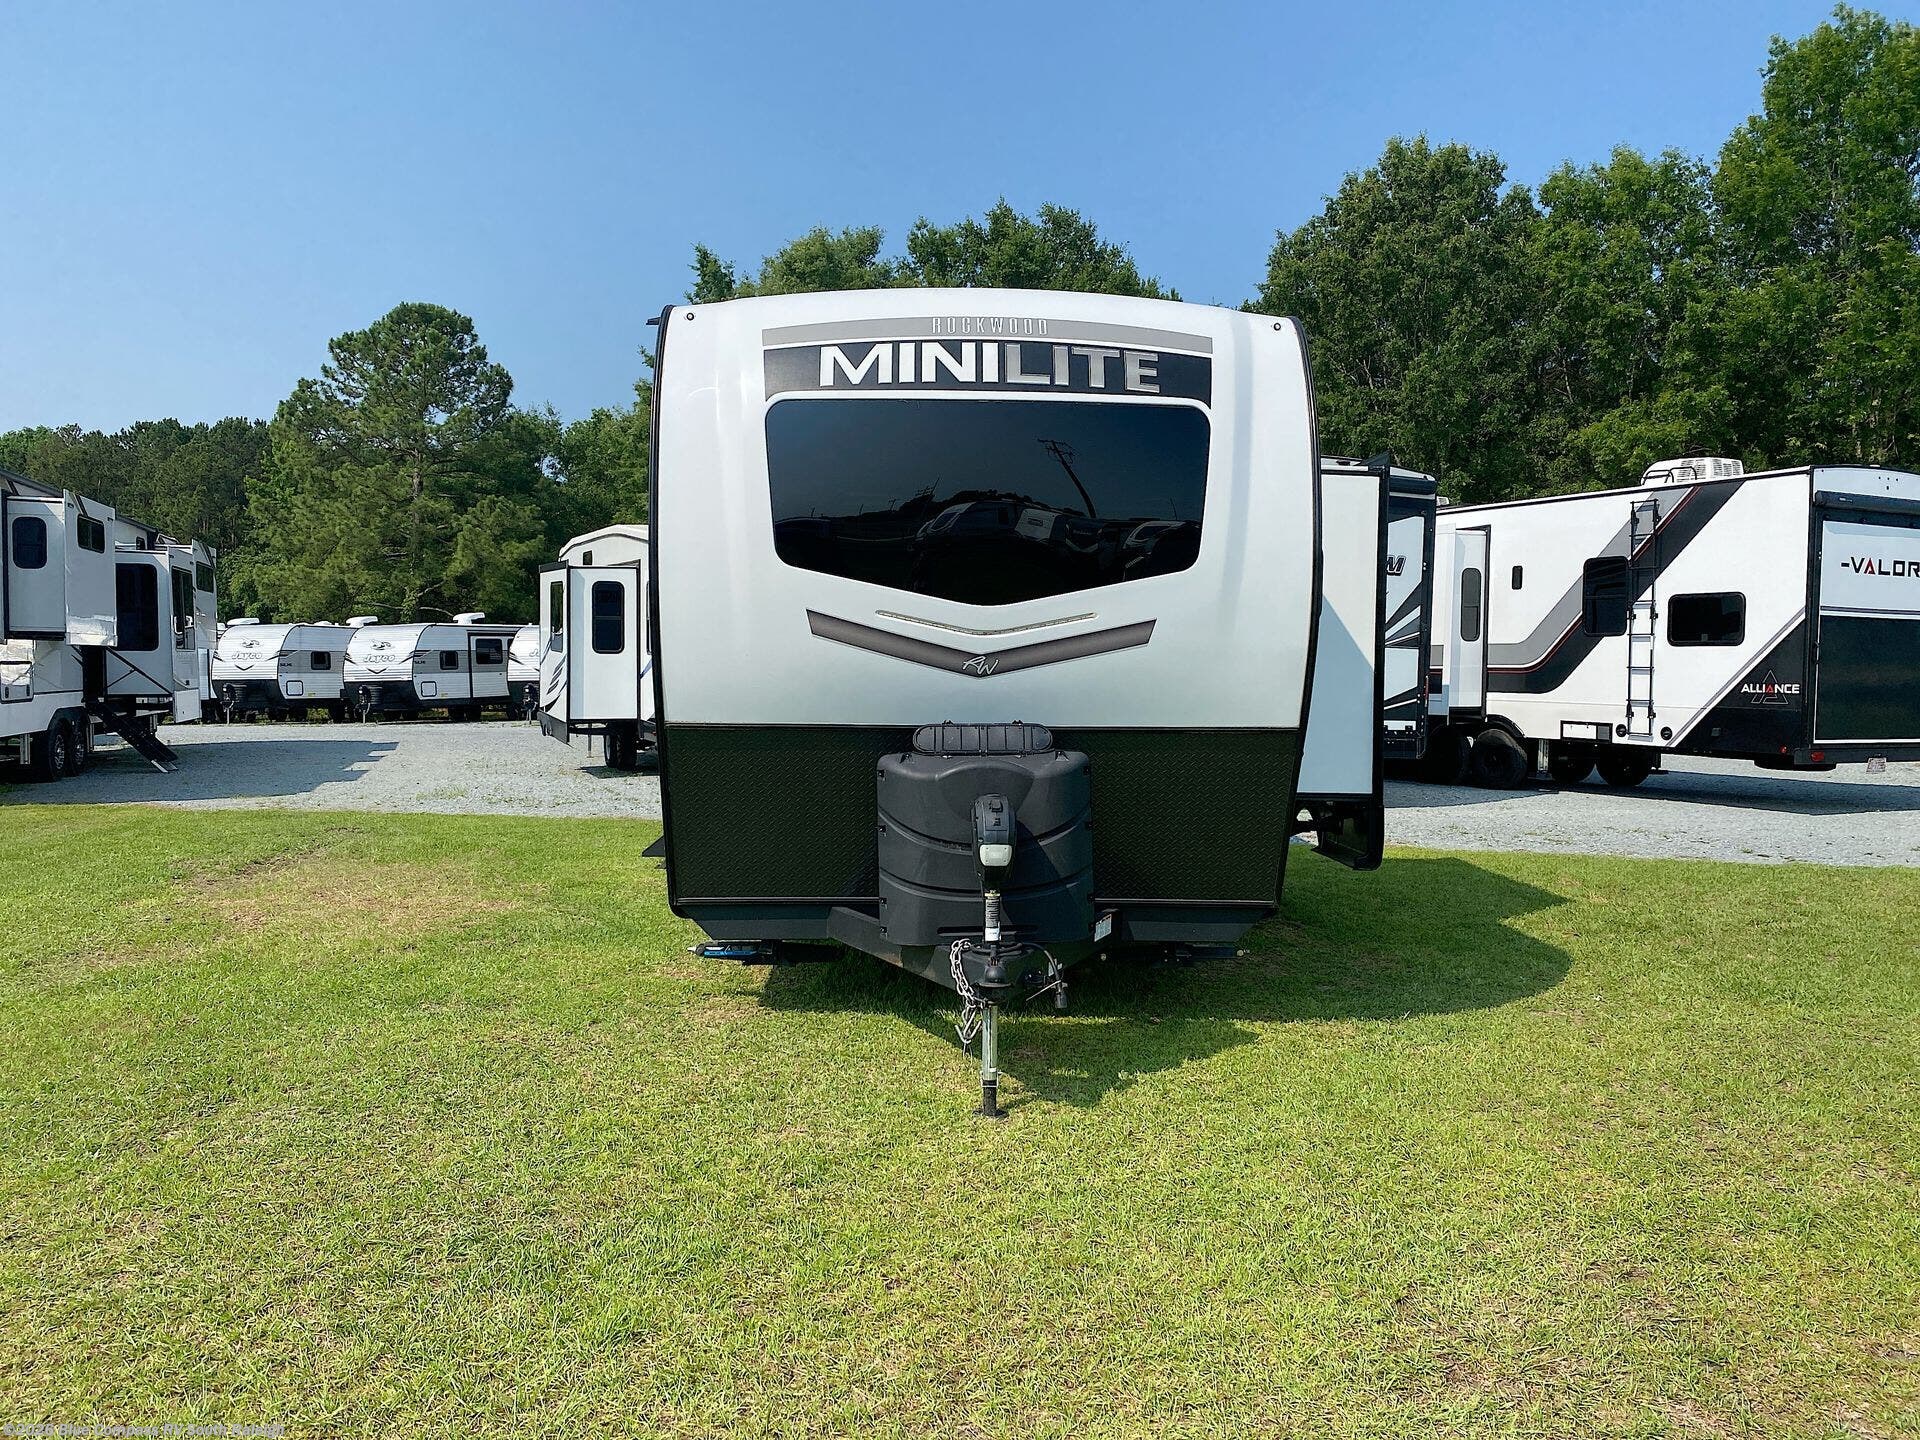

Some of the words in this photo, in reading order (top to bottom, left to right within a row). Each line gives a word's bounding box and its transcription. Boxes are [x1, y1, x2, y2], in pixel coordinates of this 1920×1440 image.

[931, 316, 1048, 335] ROCKWOOD
[819, 341, 1160, 394] MINILITE
[231, 651, 262, 661] Jayco
[363, 653, 396, 664] Jayco
[1740, 683, 1800, 694] ALLIANCE
